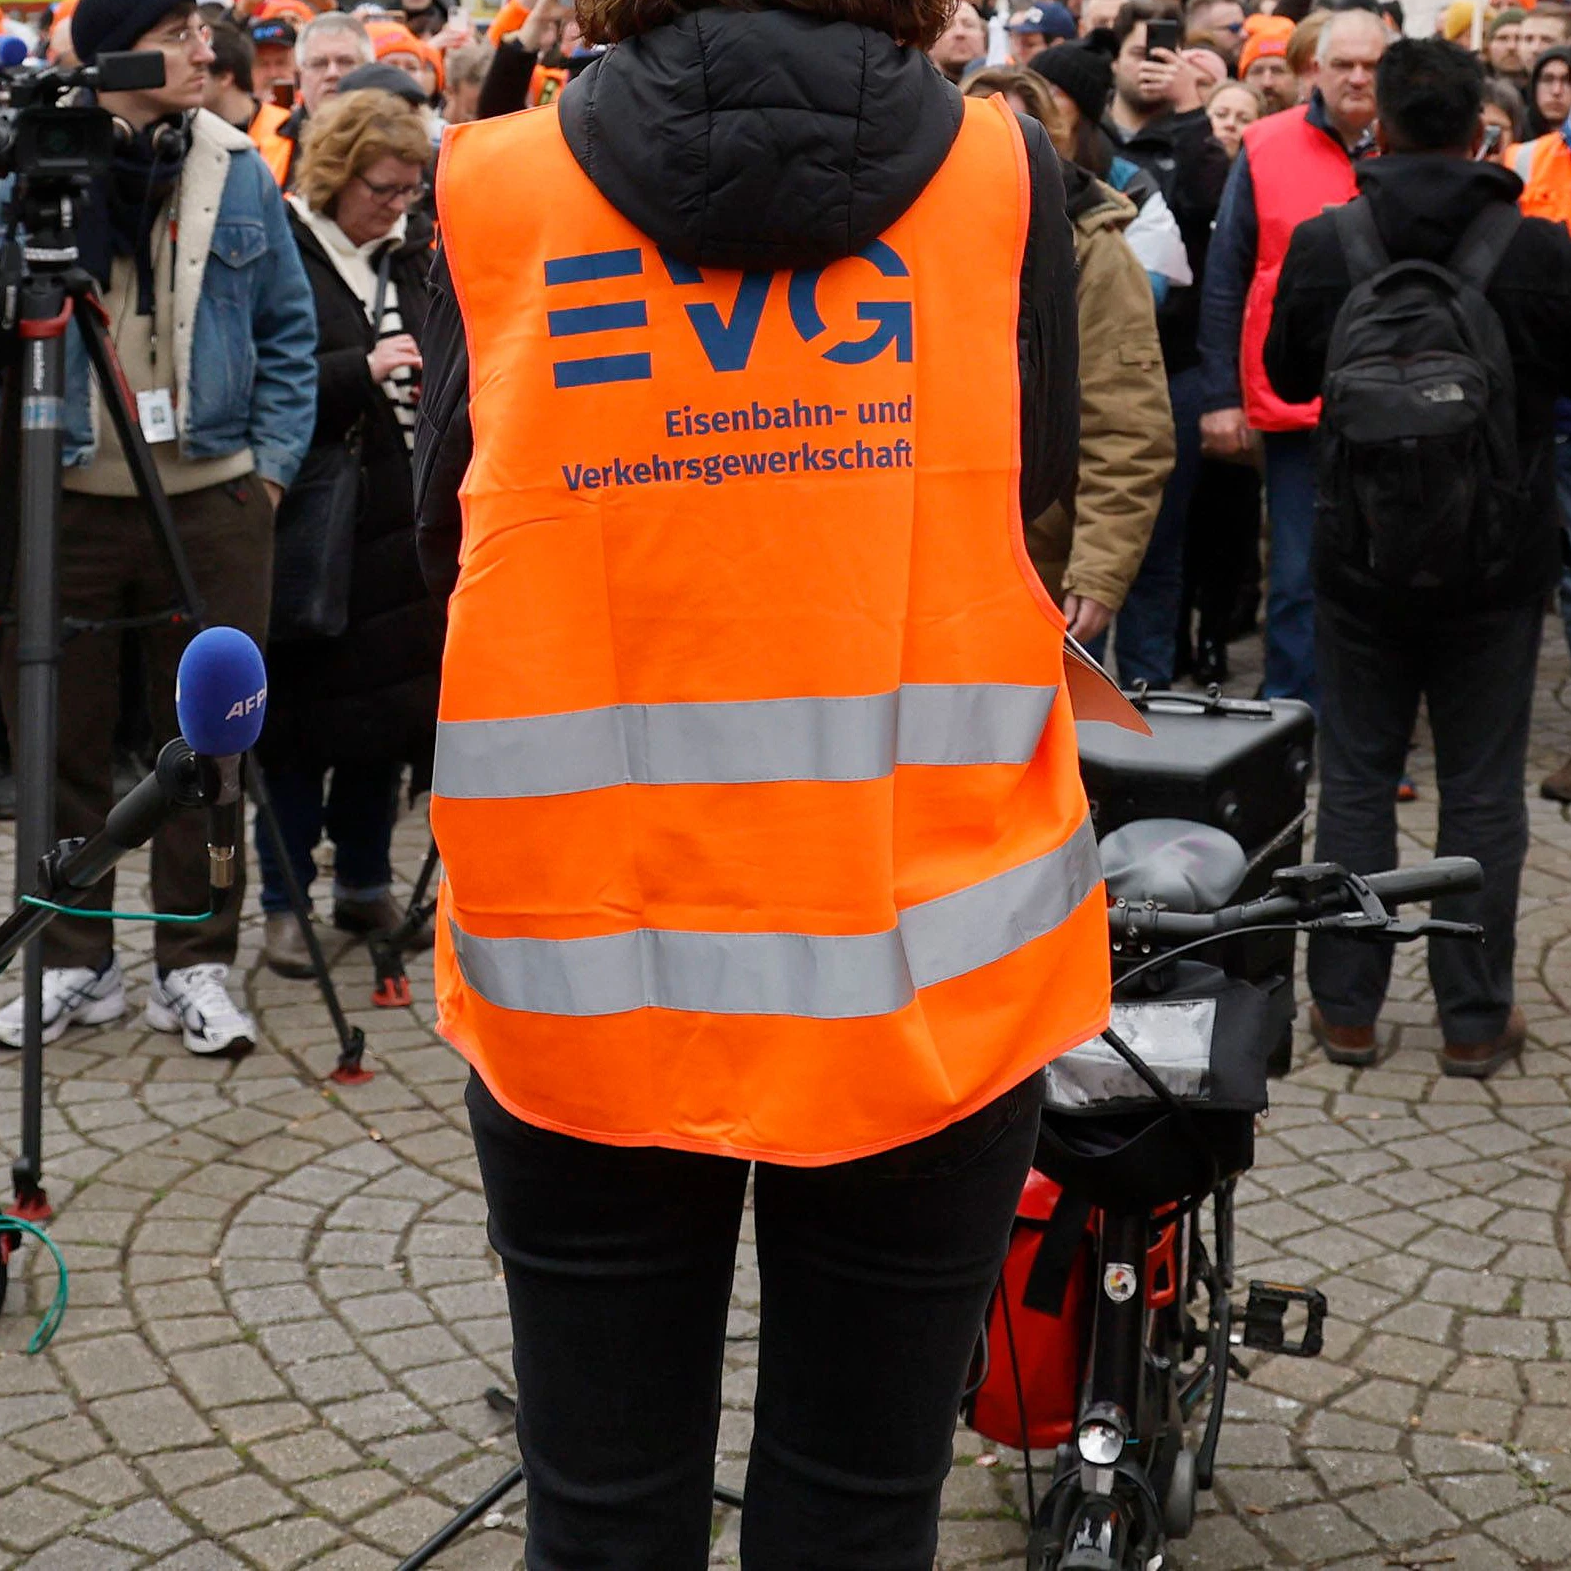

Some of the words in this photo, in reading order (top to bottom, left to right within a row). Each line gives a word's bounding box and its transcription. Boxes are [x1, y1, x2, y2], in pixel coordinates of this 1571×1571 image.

[544, 237, 914, 390] EVG
[664, 398, 847, 438] Eisenbahn-
[858, 394, 913, 426] und
[561, 438, 914, 492] Verkehrsgewerkschaft
[224, 687, 267, 721] AFP
